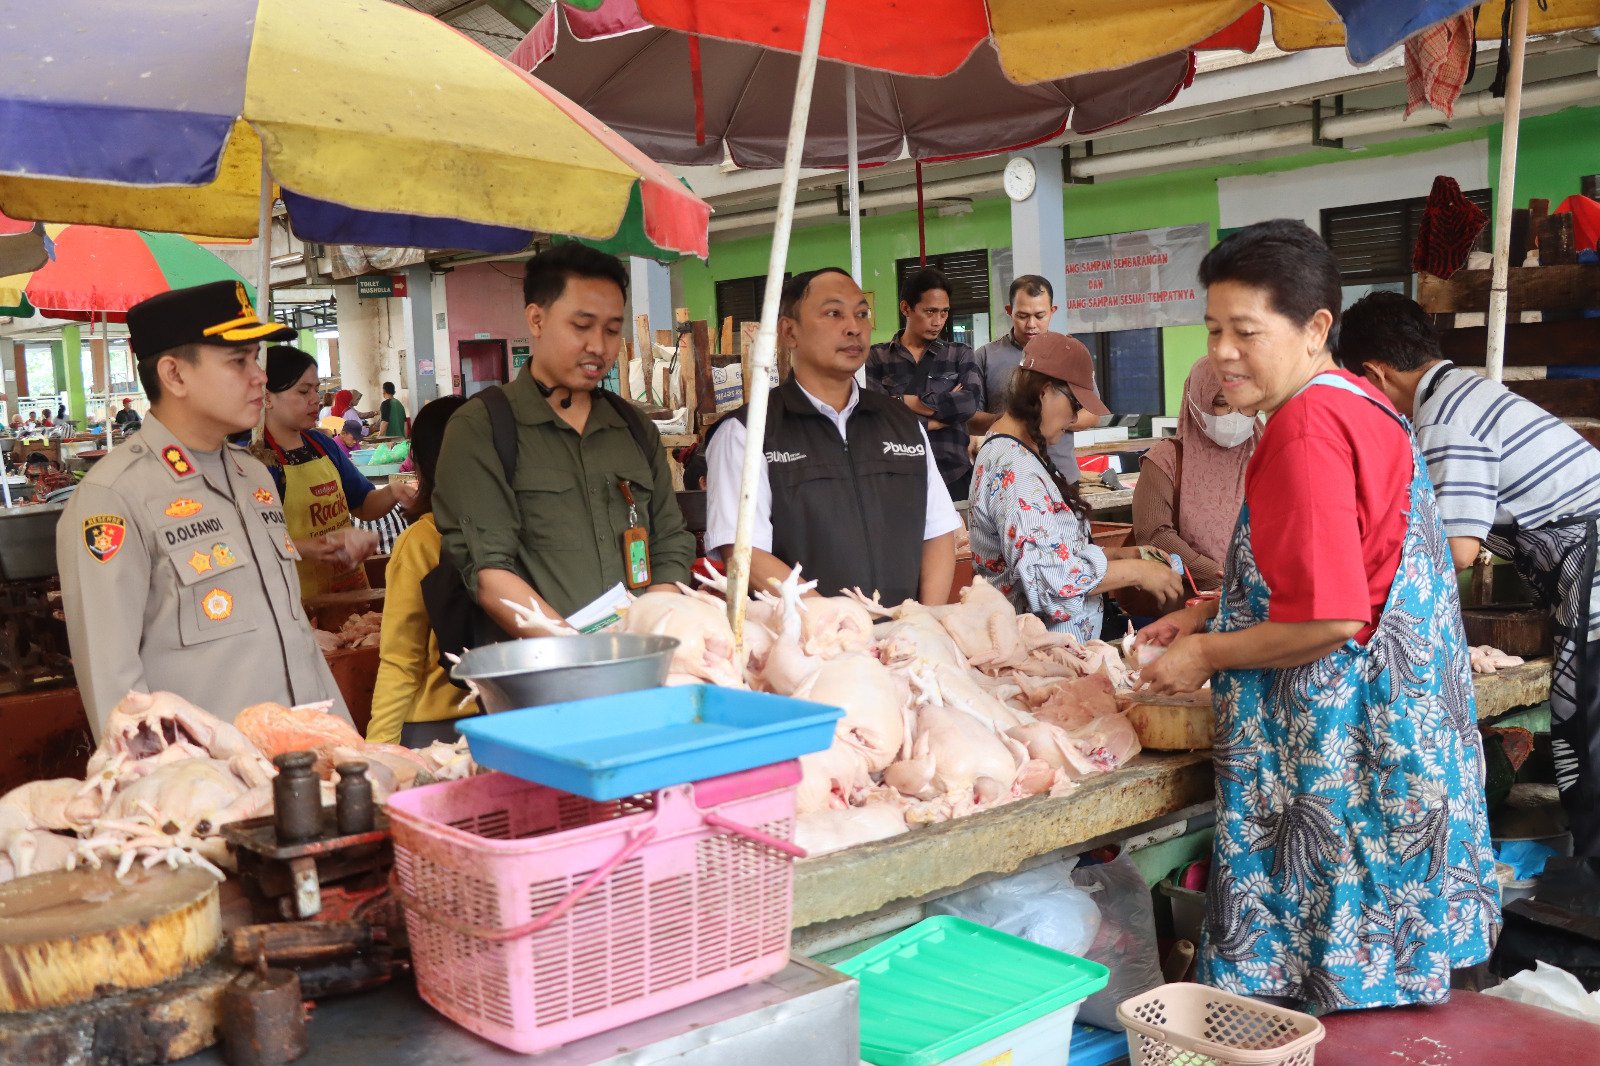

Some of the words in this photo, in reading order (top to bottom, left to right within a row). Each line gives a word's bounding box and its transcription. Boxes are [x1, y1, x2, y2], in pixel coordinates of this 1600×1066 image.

[1082, 259, 1112, 273] SAMPAH
[1113, 253, 1169, 270] SEMBARANGAN
[1088, 278, 1104, 290] DAN
[1088, 295, 1119, 308] SAMPAH
[1120, 291, 1146, 306] SESUAI
[1147, 288, 1196, 303] TEMPATNYA
[889, 441, 926, 456] bulog
[309, 492, 348, 527] Racik
[165, 517, 224, 546] D.OLFANDI
